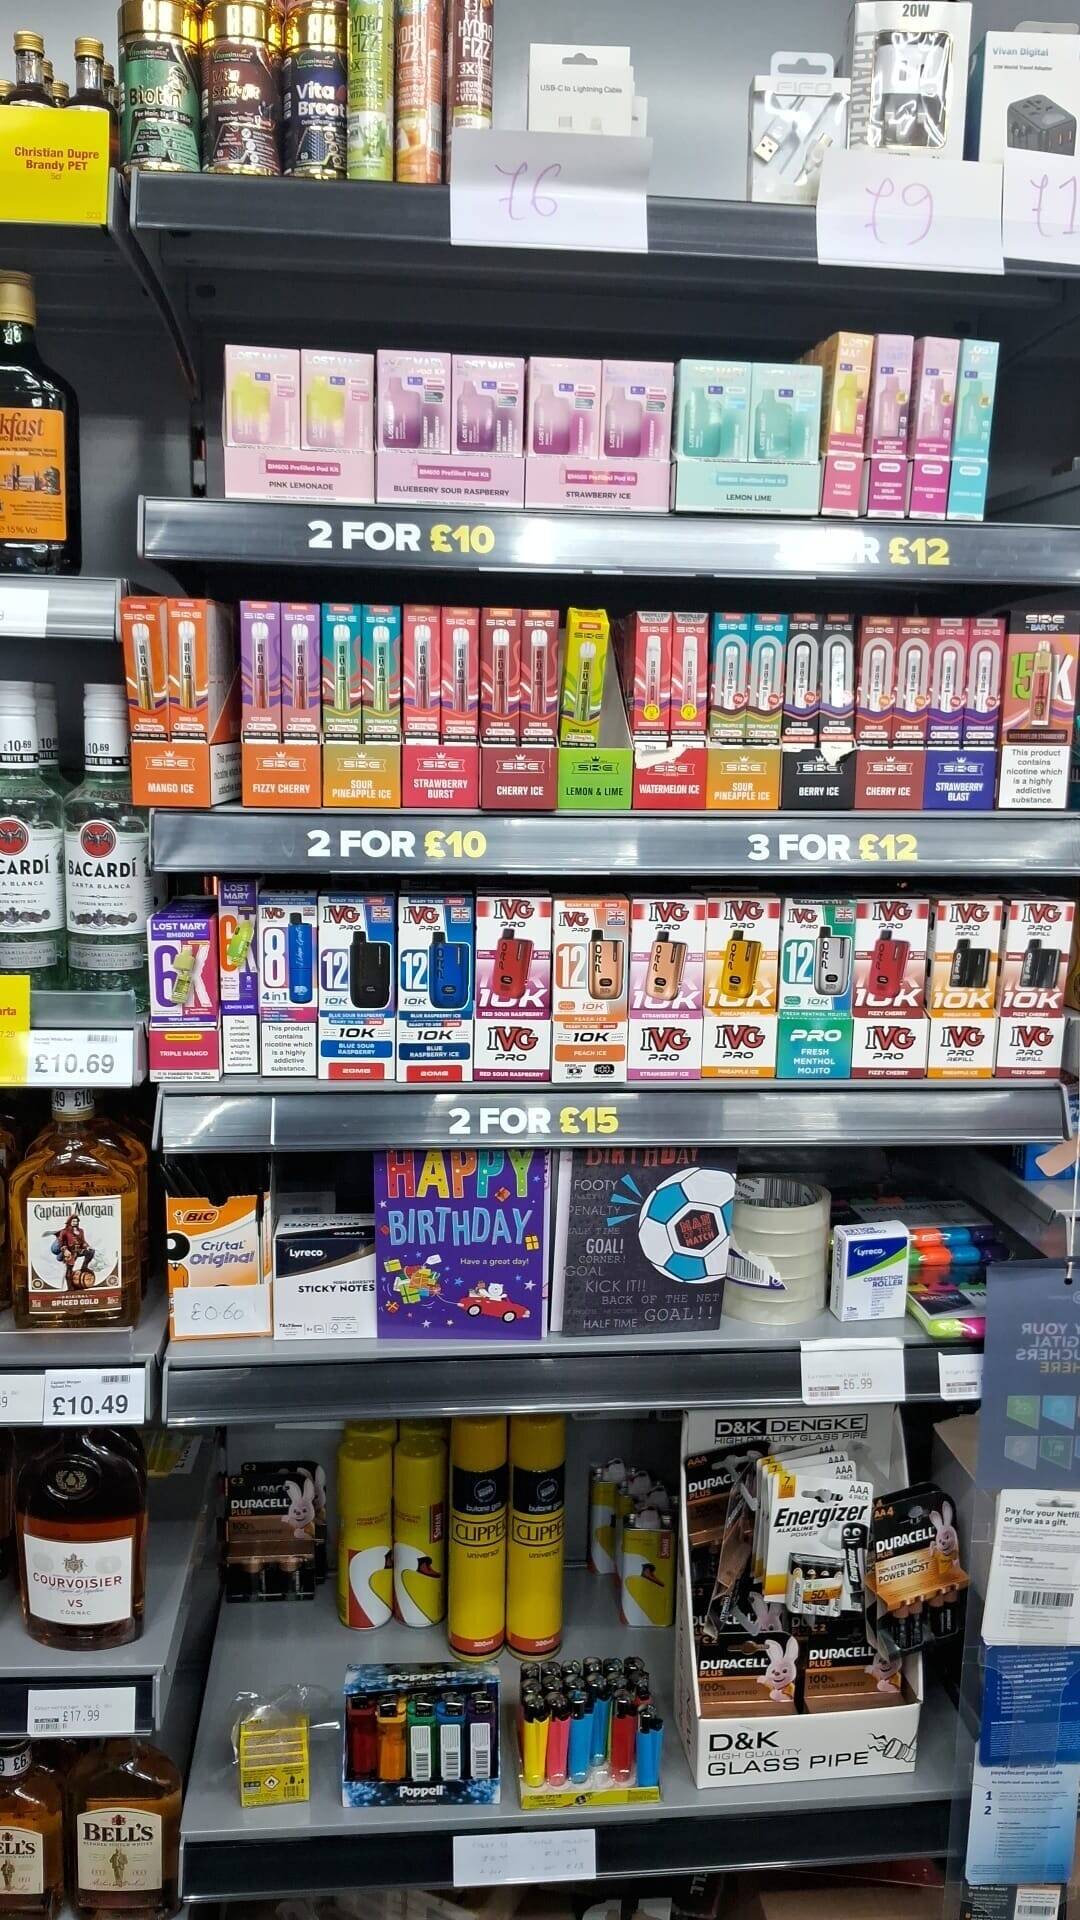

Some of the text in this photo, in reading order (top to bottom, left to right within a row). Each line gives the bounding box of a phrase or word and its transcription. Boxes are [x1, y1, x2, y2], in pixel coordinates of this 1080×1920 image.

[902, 4, 930, 17] 20W
[458, 20, 493, 42] HYDRO
[992, 47, 1049, 58] Vivan Digital
[296, 81, 335, 100] Vita
[540, 84, 563, 92] USB-C
[573, 86, 603, 94] Lightning
[15, 147, 99, 160] Christian Dupre
[26, 158, 88, 171] Brandy PET
[269, 481, 334, 491] PINK LEMONADE
[394, 485, 509, 496] BLUEBERRY SOUR RASPBERRY
[566, 491, 617, 499] STRAWBERRY
[726, 493, 772, 502] LEMON LIME
[307, 520, 495, 554] 2 FOR £10
[888, 537, 950, 565] £12
[1031, 749, 1061, 757] product
[350, 780, 372, 789] SOUR
[413, 779, 468, 790] STRAWBERRY
[732, 783, 753, 791] SOUR
[935, 782, 983, 792] STRAWBERRY
[1029, 778, 1053, 786] highly
[148, 783, 194, 794] MANGO ICE
[252, 783, 311, 794] FIZZY CHERRY
[332, 788, 392, 799] PINEAPPLE ICE
[427, 788, 454, 799] BURST
[496, 785, 544, 796] CHERRY ICE
[566, 787, 623, 796] LEMON & LIME
[639, 784, 700, 794] WATERMELON ICE
[799, 787, 839, 796] BERRY ICE
[714, 791, 770, 800] PINEAPPLE ICE
[948, 792, 970, 801] BLAST
[306, 830, 487, 859] 2 FOR £10
[747, 834, 918, 861] 3 FOR £12
[69, 857, 136, 877] BACARDÍ
[224, 884, 249, 892] LOST
[224, 892, 249, 900] MARY
[153, 923, 206, 931] LOST MARY
[340, 1028, 375, 1038] 10K
[573, 1033, 609, 1042] 10K
[791, 1030, 841, 1042] PRO
[866, 1026, 915, 1050] IVG
[487, 1027, 538, 1051] IVG
[35, 1053, 115, 1074] £10.69
[449, 1107, 618, 1136] 2 FOR £15
[387, 1151, 533, 1198] HAPPY
[33, 1201, 114, 1219] Captain Morgan
[388, 1206, 532, 1245] BIRTHDAY
[586, 1238, 623, 1254] GOAL!
[289, 1249, 324, 1259] Lyreco
[857, 1247, 882, 1257] Lyreco
[190, 1251, 254, 1268] Original
[513, 1258, 528, 1266] day!
[298, 1284, 375, 1293] STICKY NOTES
[586, 1280, 622, 1292] KICK
[872, 1279, 903, 1288] ROLLER
[51, 1297, 99, 1306] SPICED GOLD
[602, 1294, 720, 1304] BACK OF THE NET
[844, 1378, 872, 1390] £6.99
[52, 1394, 128, 1416] £10.49
[717, 1417, 864, 1435] D&K DENGKE
[715, 1436, 742, 1445] HIGH
[800, 1433, 838, 1441] GLASS
[841, 1432, 868, 1440] PIPE
[231, 1499, 289, 1509] DURACELL
[774, 1504, 869, 1528] Energizer
[1005, 1507, 1021, 1516] Pay
[1023, 1508, 1034, 1516] for
[1036, 1510, 1055, 1519] your
[1052, 1519, 1068, 1527] gift.
[875, 1527, 936, 1553] DURACELL
[33, 1572, 122, 1589] COURVOISIER
[68, 1599, 83, 1608] VS
[809, 1647, 874, 1660] DURACELL
[700, 1658, 768, 1669] DURACELL
[809, 1659, 832, 1668] PLUS
[63, 1710, 100, 1722] £17.99
[709, 1732, 779, 1752] D&K
[708, 1748, 802, 1760] HIGH QUALITY
[708, 1752, 870, 1777] GLASS PIPE
[399, 1785, 445, 1799] Poppell
[83, 1822, 153, 1842] BELL'S
